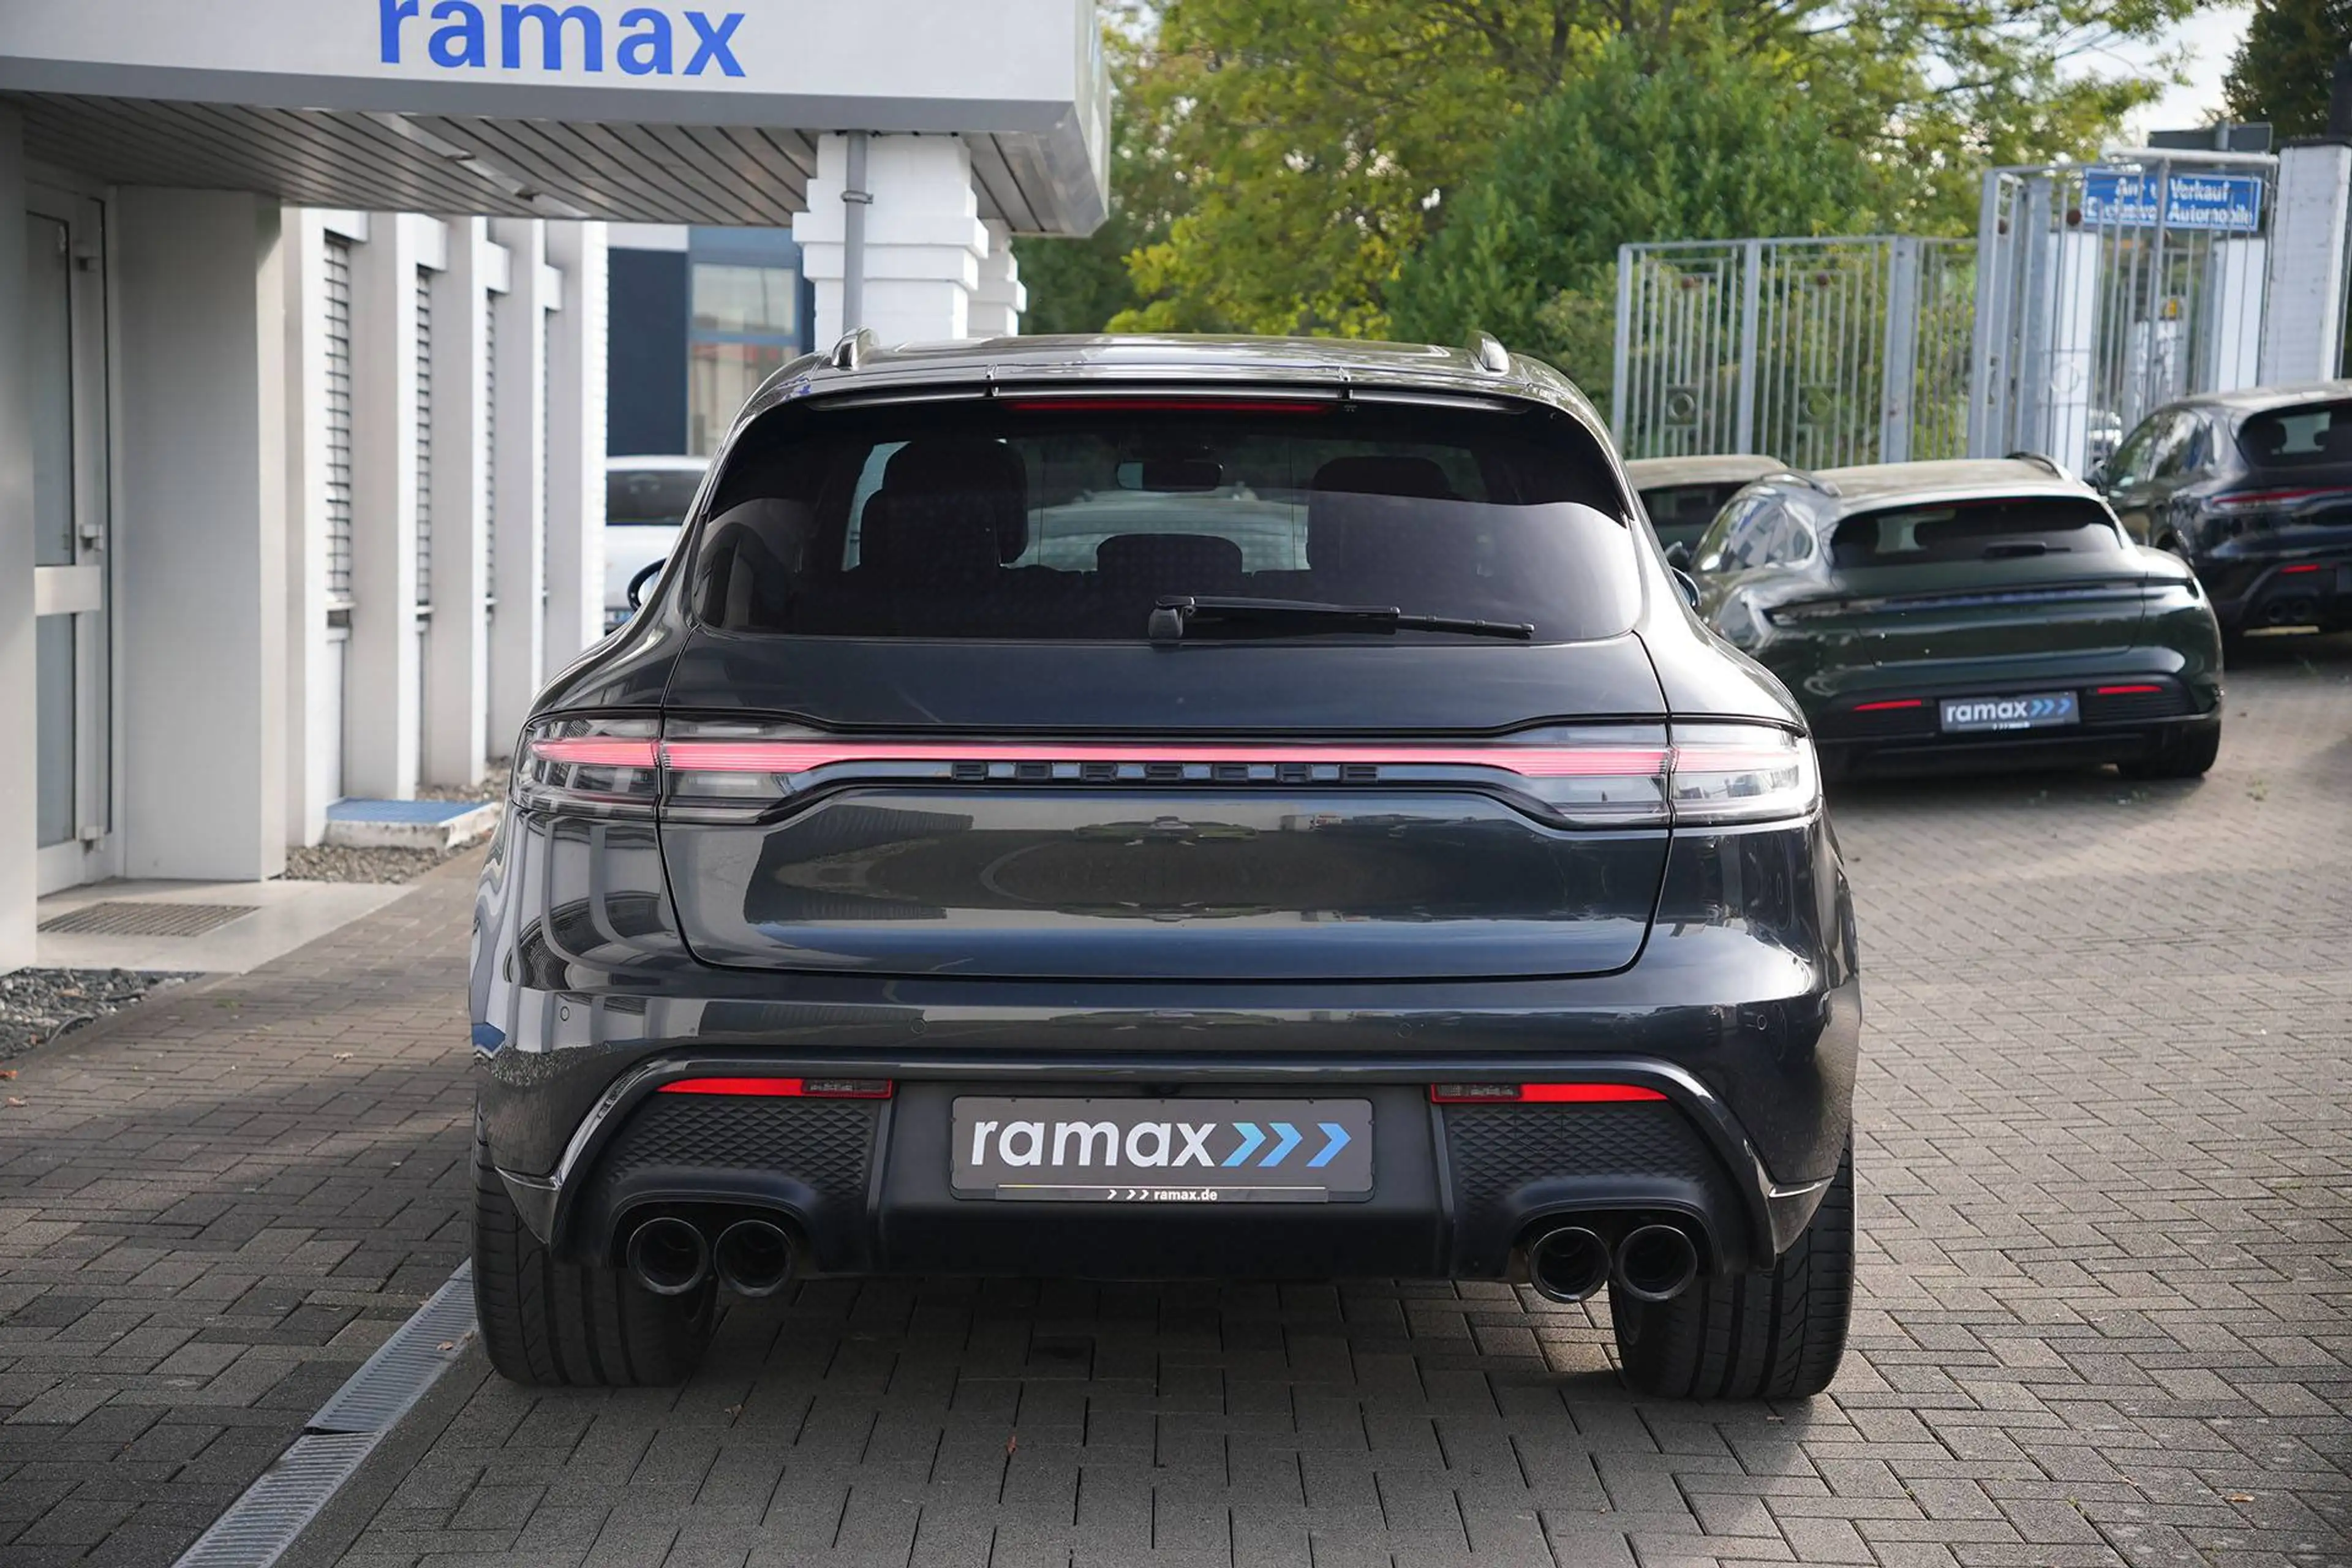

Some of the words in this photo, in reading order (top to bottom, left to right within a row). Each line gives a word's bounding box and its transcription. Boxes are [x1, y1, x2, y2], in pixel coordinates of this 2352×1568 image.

[379, 0, 746, 78] ramax
[2169, 178, 2230, 202] Verkauf
[1946, 701, 2028, 723] ramax
[971, 1120, 1217, 1167] ramax
[1153, 1188, 1218, 1201] ramax.de
